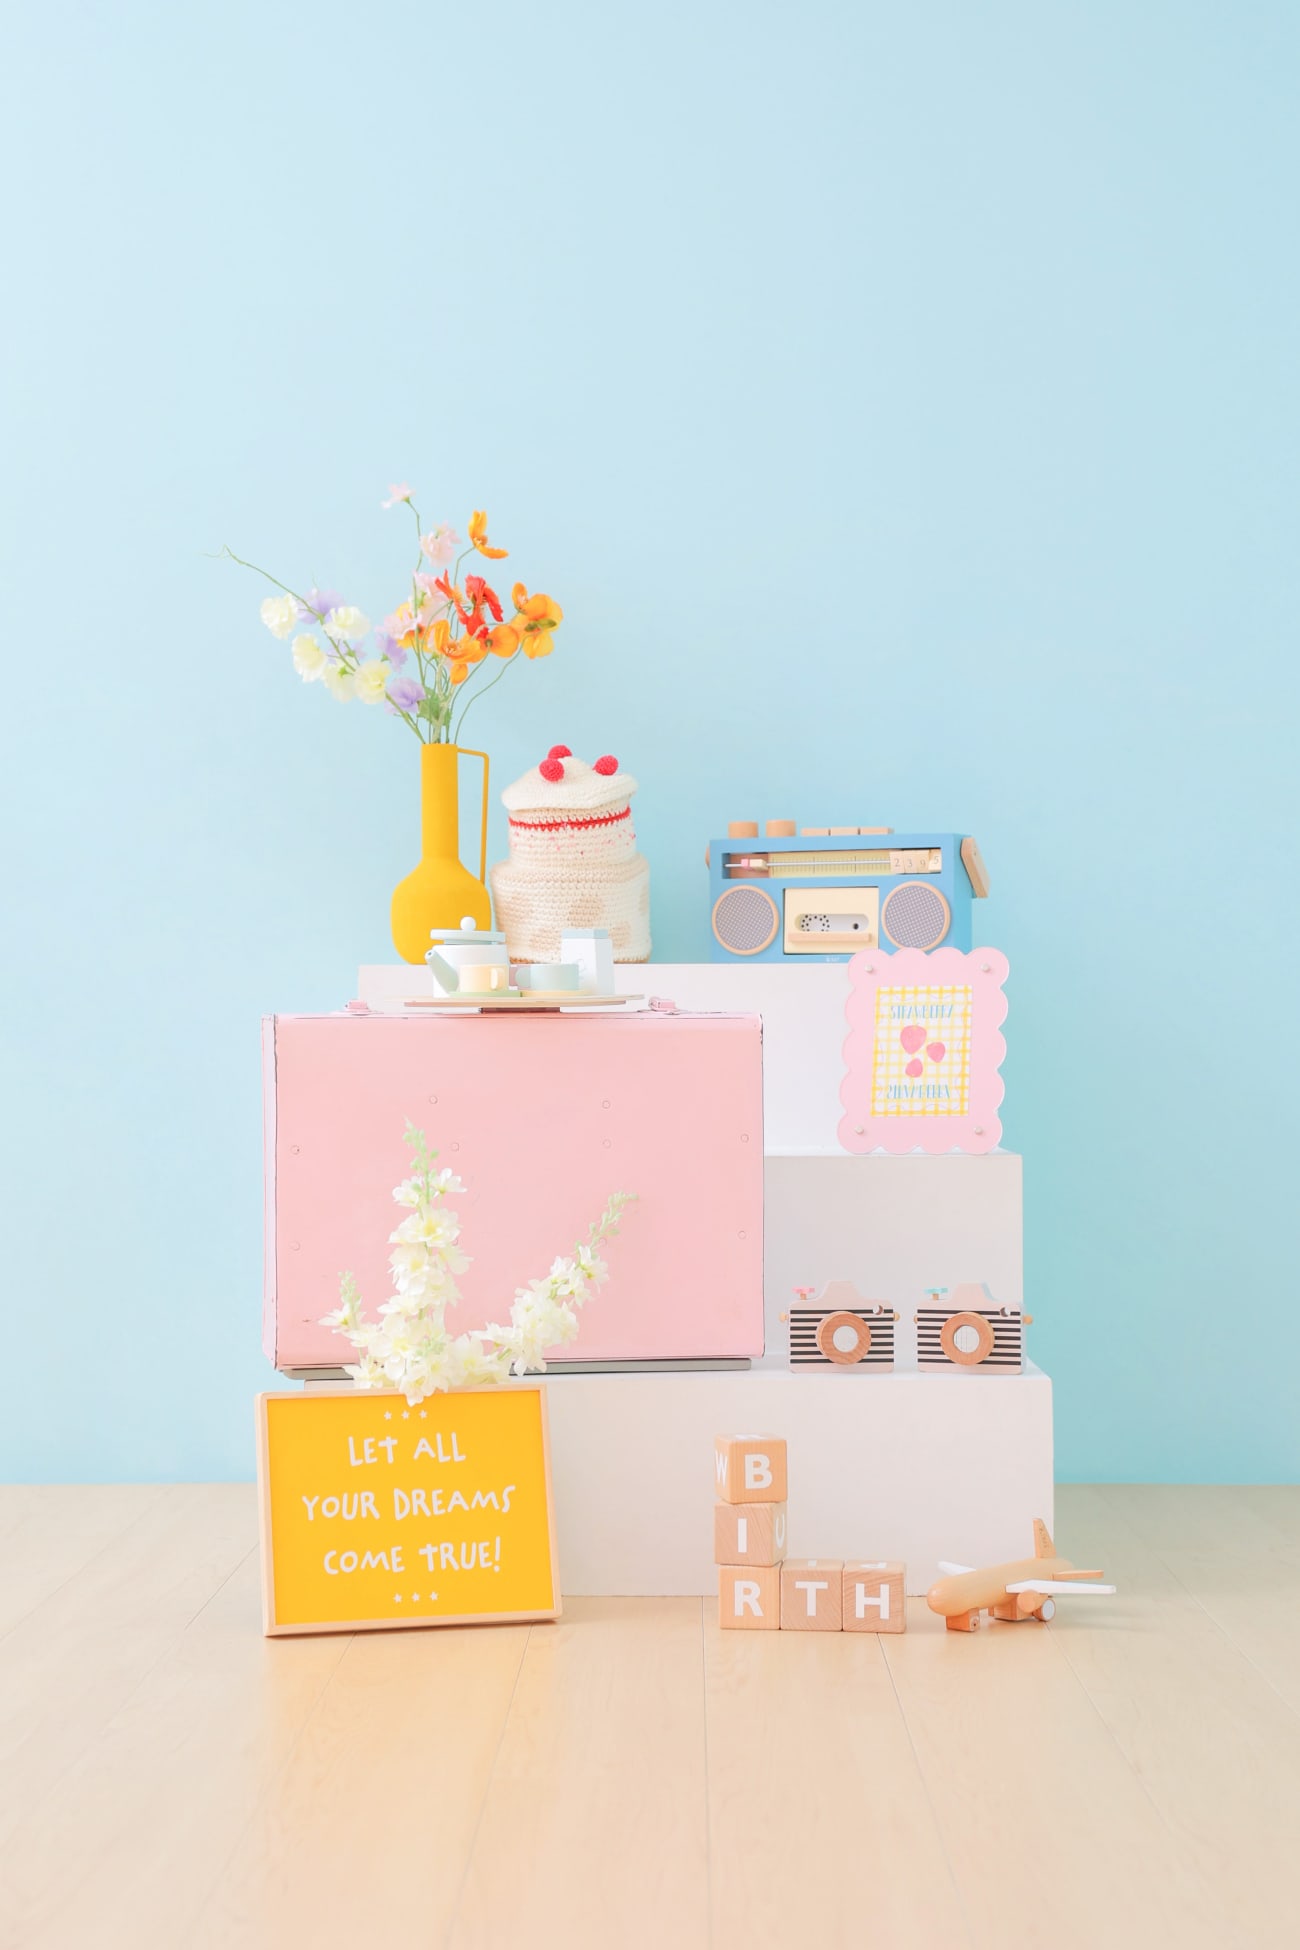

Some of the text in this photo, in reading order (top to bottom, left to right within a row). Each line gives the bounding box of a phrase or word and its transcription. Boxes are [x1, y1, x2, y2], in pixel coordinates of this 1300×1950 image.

[348, 1432, 466, 1467] LET ALL
[744, 1453, 773, 1489] B
[302, 1485, 516, 1521] YOUR DREAMS
[323, 1536, 501, 1575] COME TRUE!
